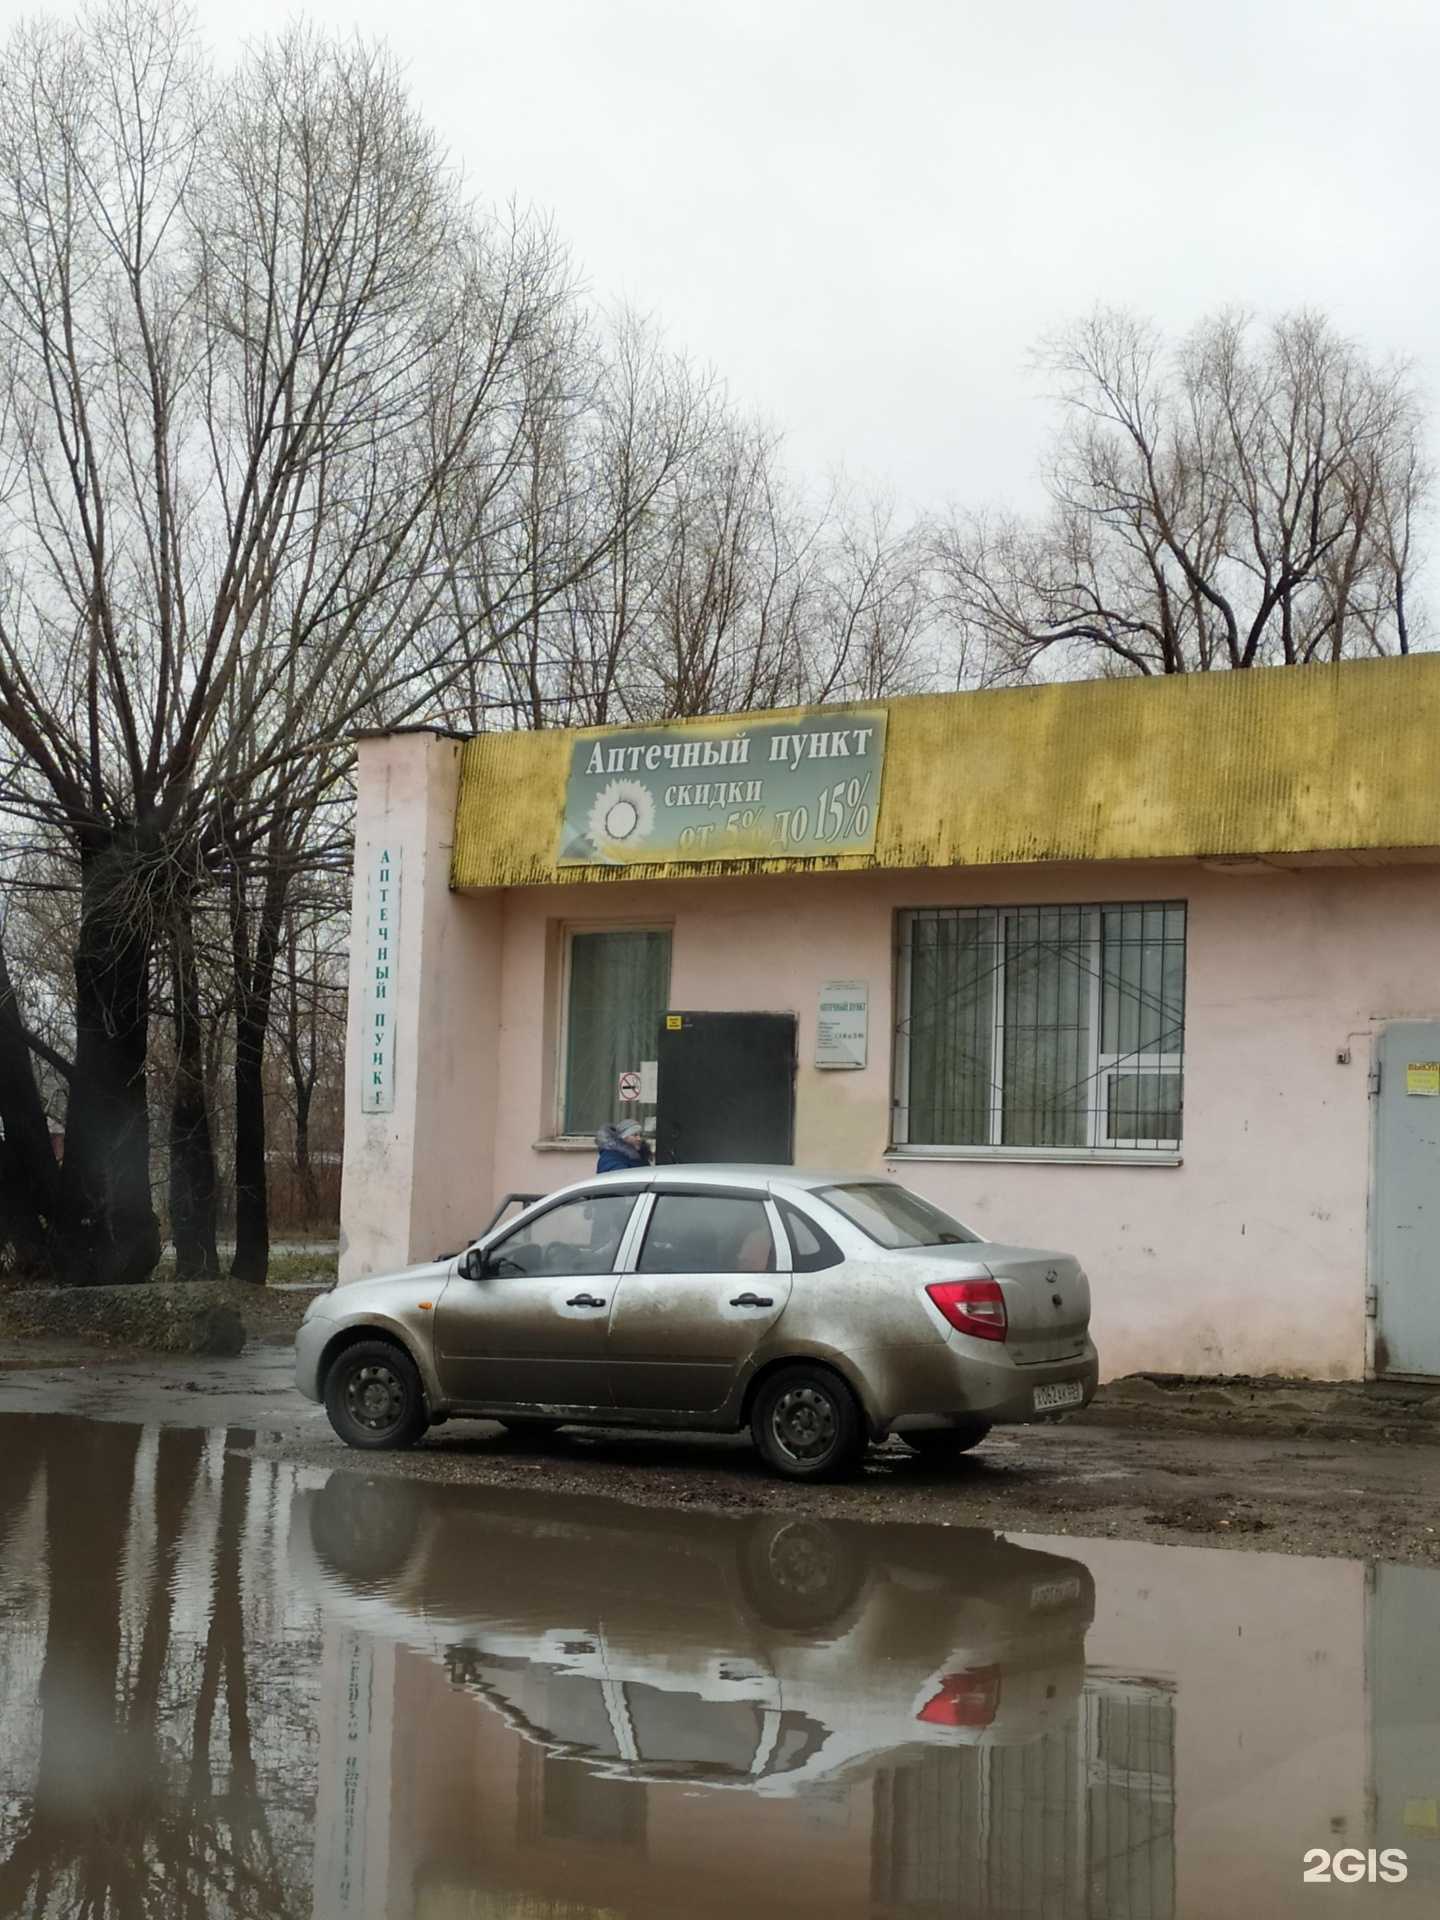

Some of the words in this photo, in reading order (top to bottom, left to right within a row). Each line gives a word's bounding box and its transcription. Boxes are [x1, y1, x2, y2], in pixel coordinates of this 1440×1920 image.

[585, 733, 751, 775] Аптечный
[768, 728, 873, 770] пункт
[664, 779, 763, 808] скидки
[679, 822, 714, 851] от
[769, 807, 809, 850] до
[815, 772, 872, 843] 15%
[375, 849, 390, 999] АПТЕЧНЫЙ
